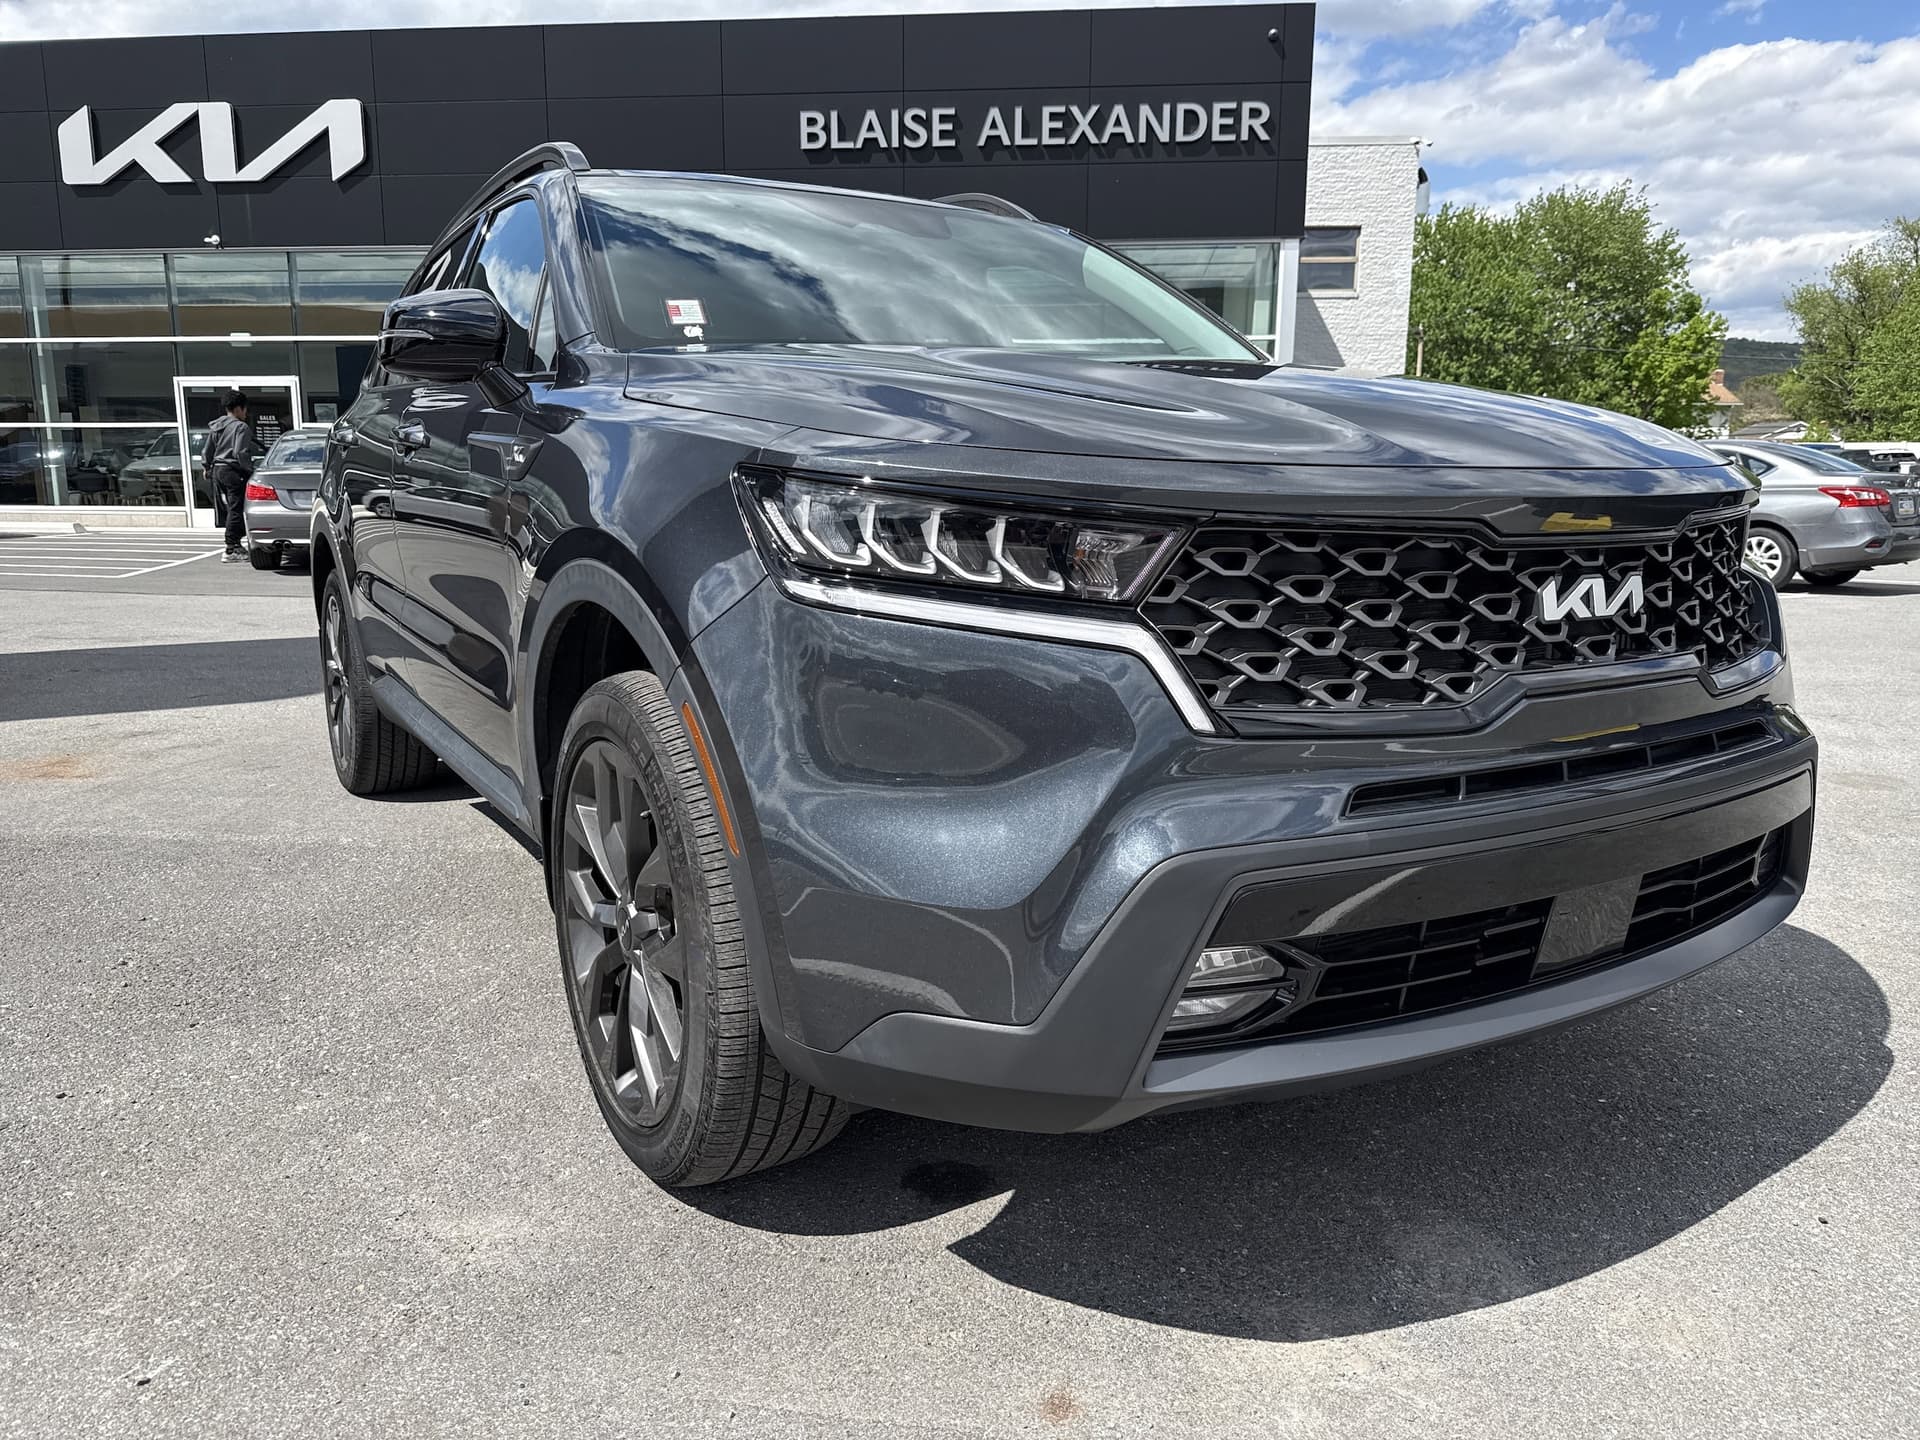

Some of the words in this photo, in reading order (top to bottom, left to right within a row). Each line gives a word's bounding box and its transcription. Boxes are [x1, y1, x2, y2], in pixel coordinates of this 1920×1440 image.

[57, 98, 366, 185] KIA
[799, 107, 956, 151] BLAISE
[976, 101, 1272, 148] ALEXANDER
[1541, 574, 1645, 622] KIA
